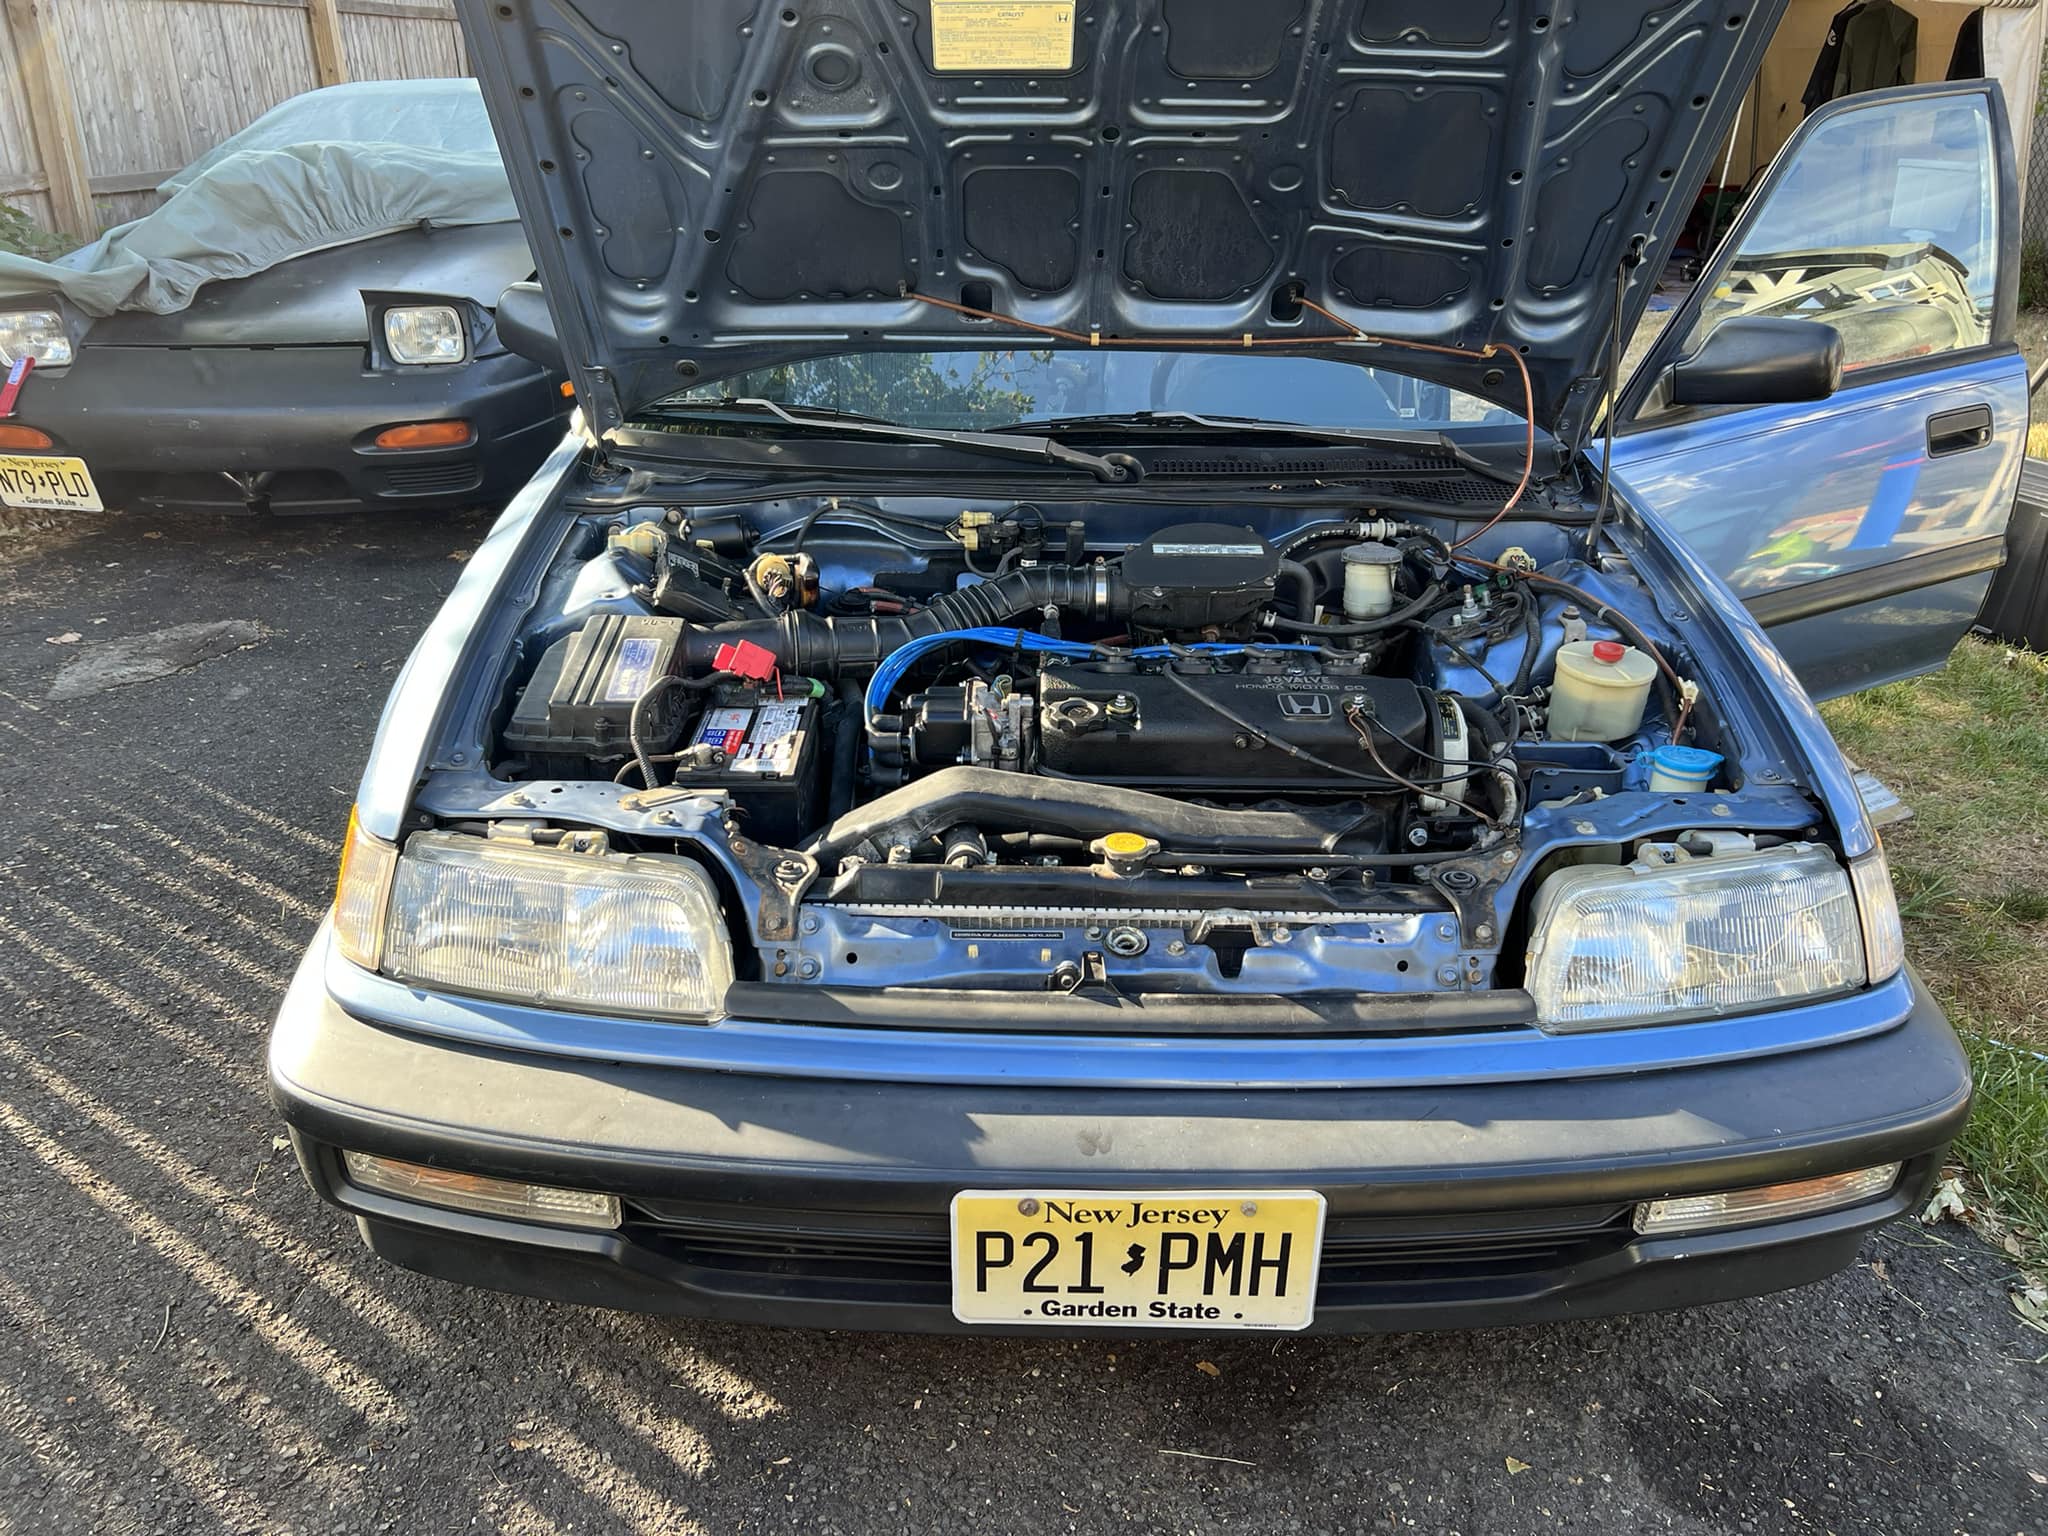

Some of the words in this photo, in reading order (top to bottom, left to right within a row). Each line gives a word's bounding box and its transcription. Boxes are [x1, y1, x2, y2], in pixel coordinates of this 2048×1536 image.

[8, 458, 30, 466] New
[31, 459, 60, 469] Jersey
[0, 468, 36, 494] N79
[45, 471, 89, 497] PLD
[25, 496, 54, 504] Garden
[55, 498, 76, 506] State
[1044, 1201, 1122, 1224] New
[1126, 1202, 1230, 1228] Jersey
[976, 1231, 1104, 1294] P21
[1157, 1232, 1293, 1297] PMH
[1040, 1301, 1138, 1318] Garden
[1148, 1301, 1221, 1319] State
